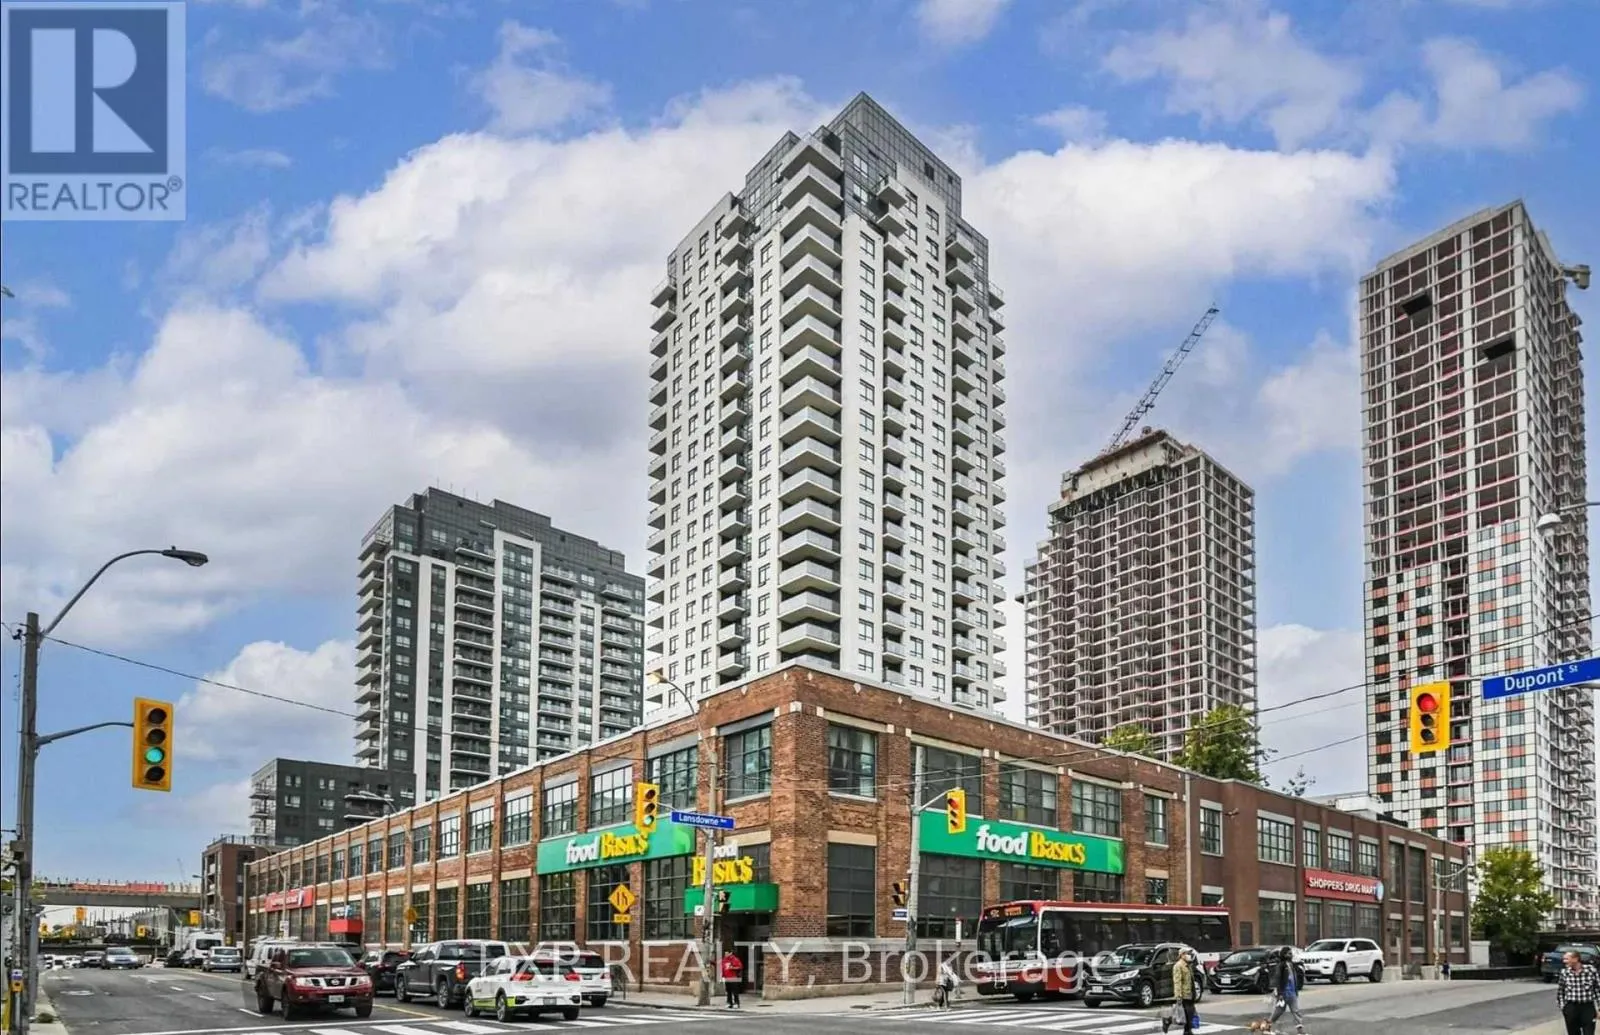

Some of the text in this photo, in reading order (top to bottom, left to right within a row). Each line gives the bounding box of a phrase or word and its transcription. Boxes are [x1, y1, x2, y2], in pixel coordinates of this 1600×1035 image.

[1504, 665, 1578, 691] Dupont St
[679, 813, 719, 826] Lansdowne
[566, 836, 599, 864] food
[713, 840, 738, 858] ood
[976, 824, 1028, 856] food
[1309, 877, 1376, 895] SHOPPERS DRUG MART
